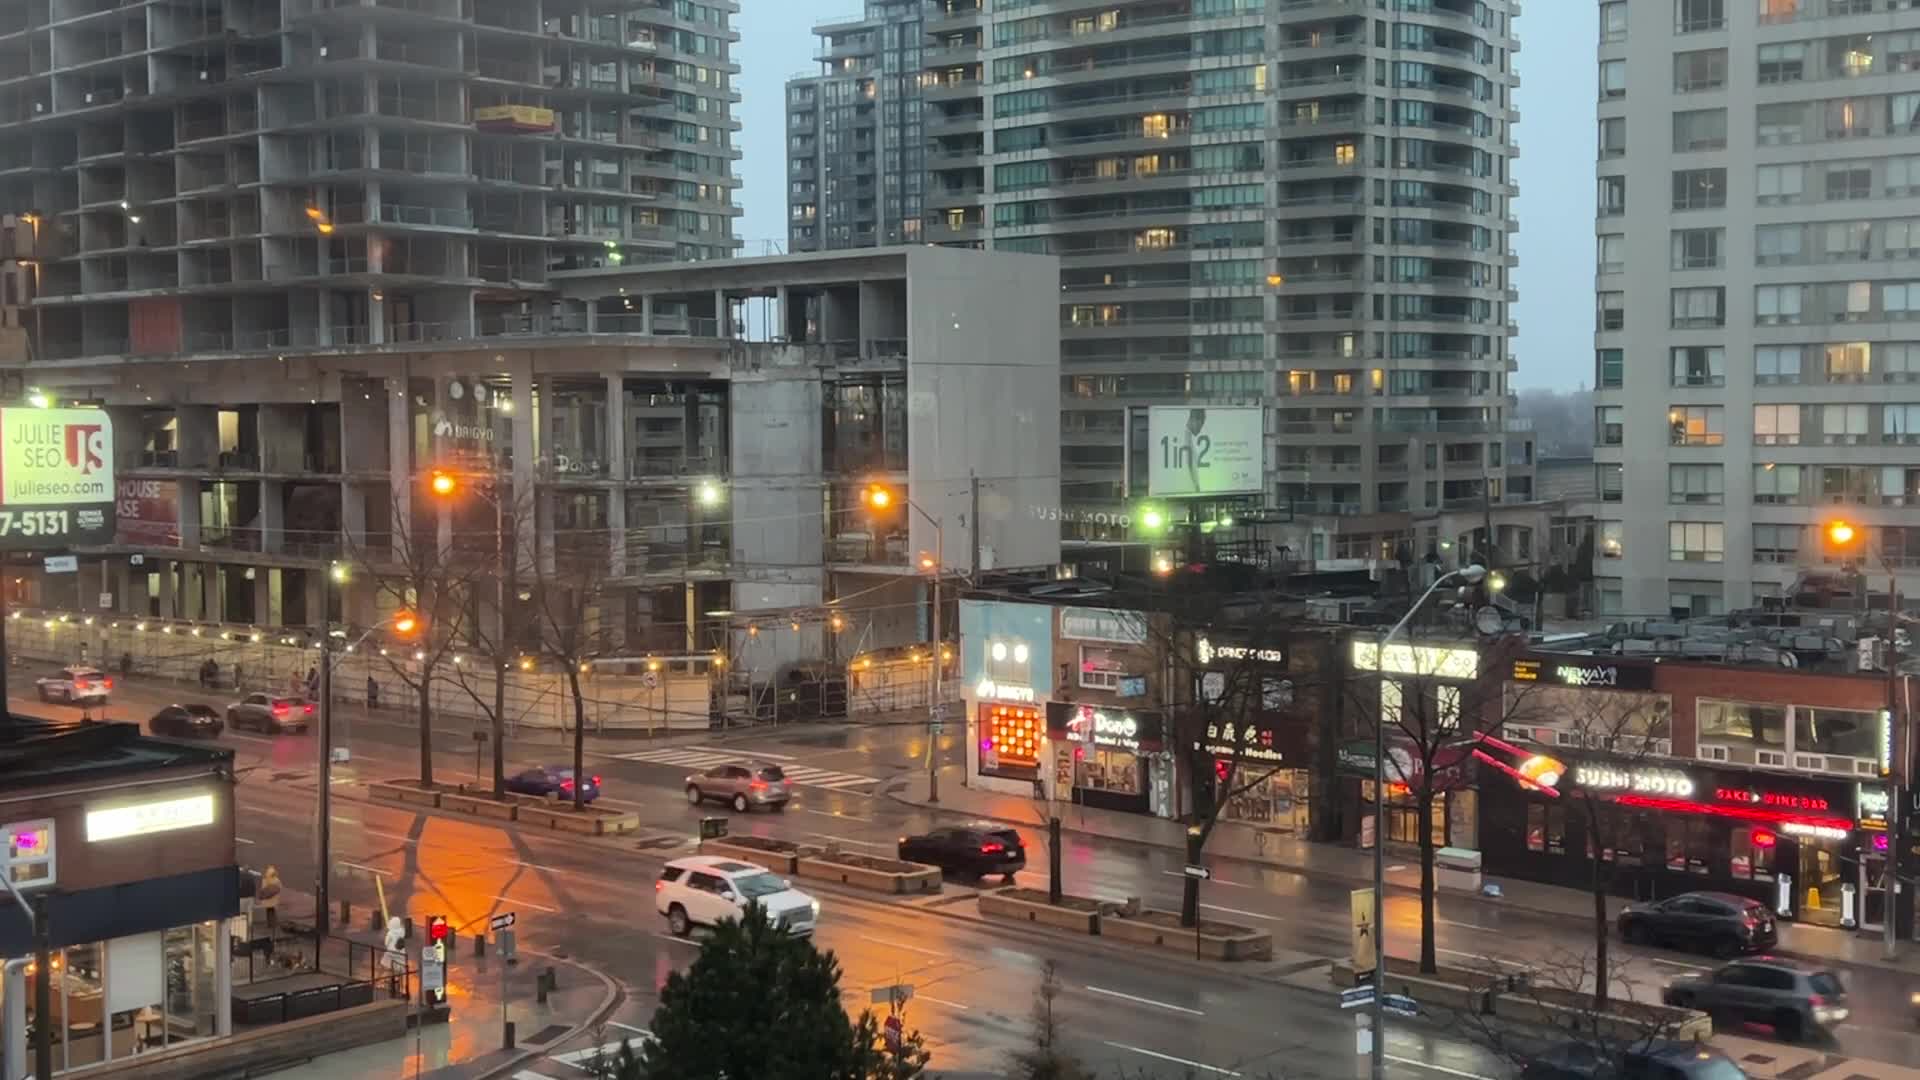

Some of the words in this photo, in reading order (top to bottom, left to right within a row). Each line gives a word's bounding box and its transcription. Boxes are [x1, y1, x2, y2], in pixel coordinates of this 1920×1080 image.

[13, 423, 62, 445] JULIE
[23, 447, 62, 468] SEO
[14, 480, 104, 499] julieseo.com
